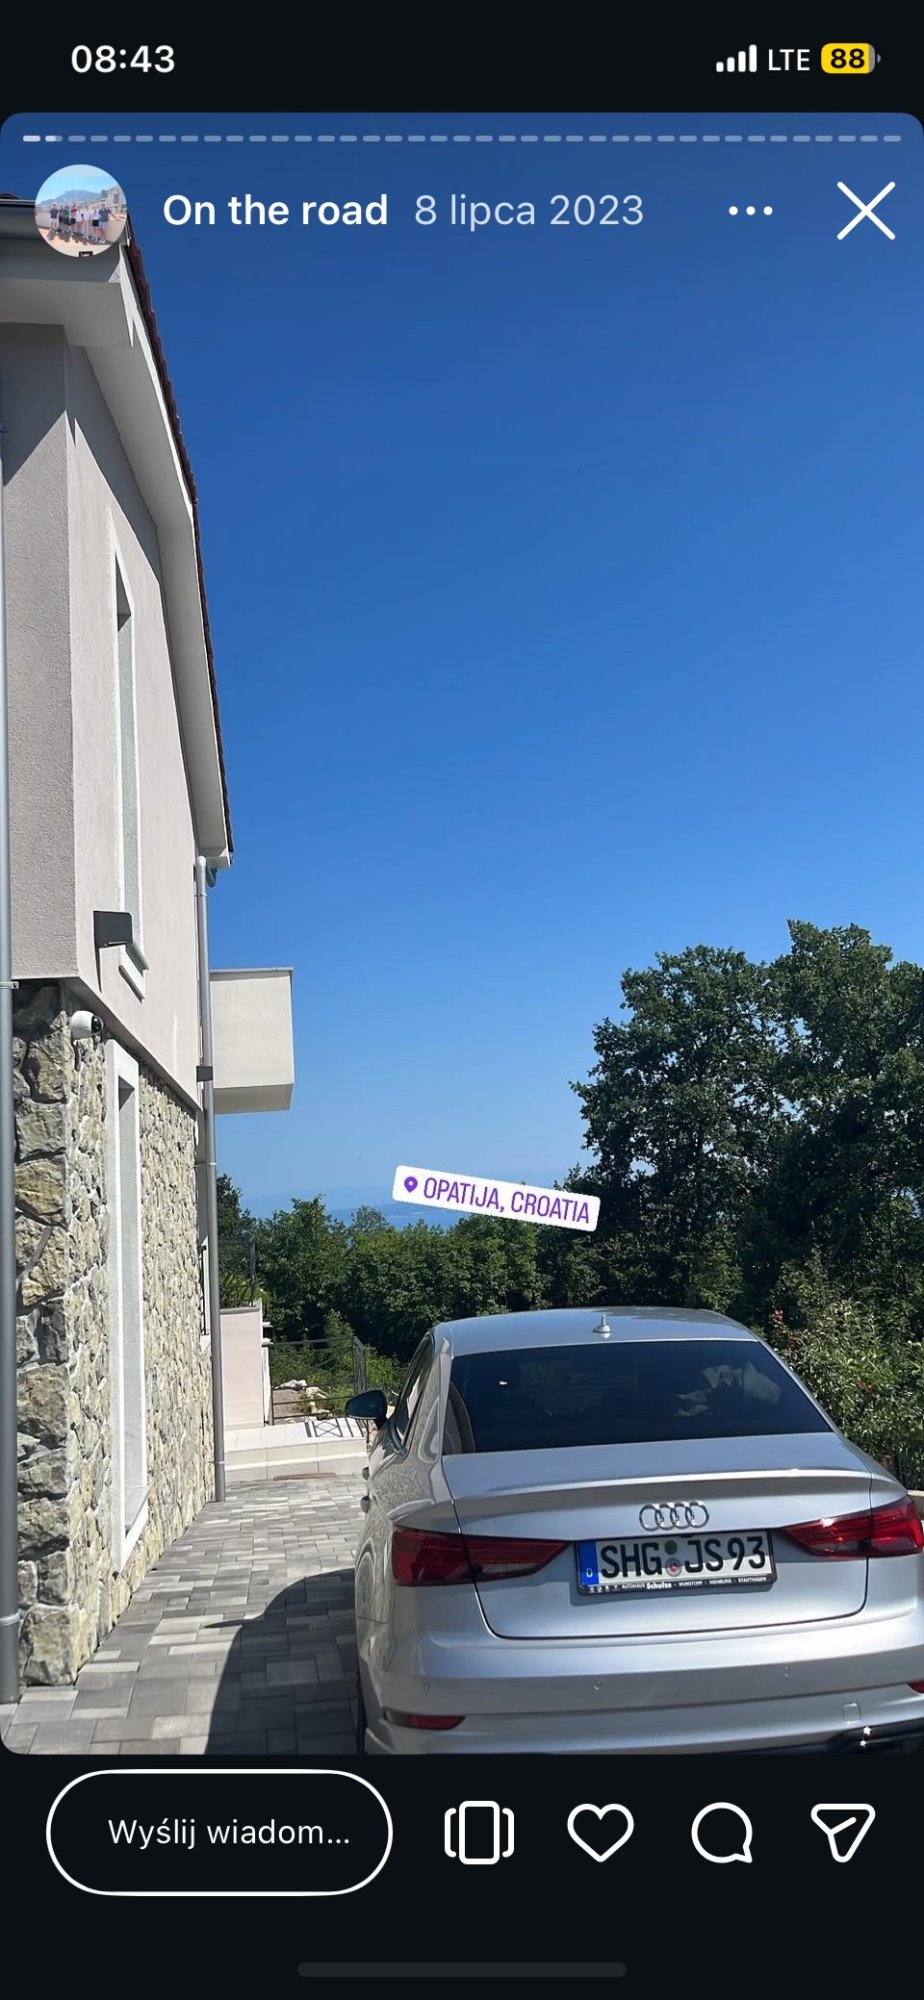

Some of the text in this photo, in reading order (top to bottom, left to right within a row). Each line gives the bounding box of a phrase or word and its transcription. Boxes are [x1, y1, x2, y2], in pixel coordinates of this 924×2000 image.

[600, 1535, 767, 1579] SHG JS 93
[586, 1568, 594, 1578] D
